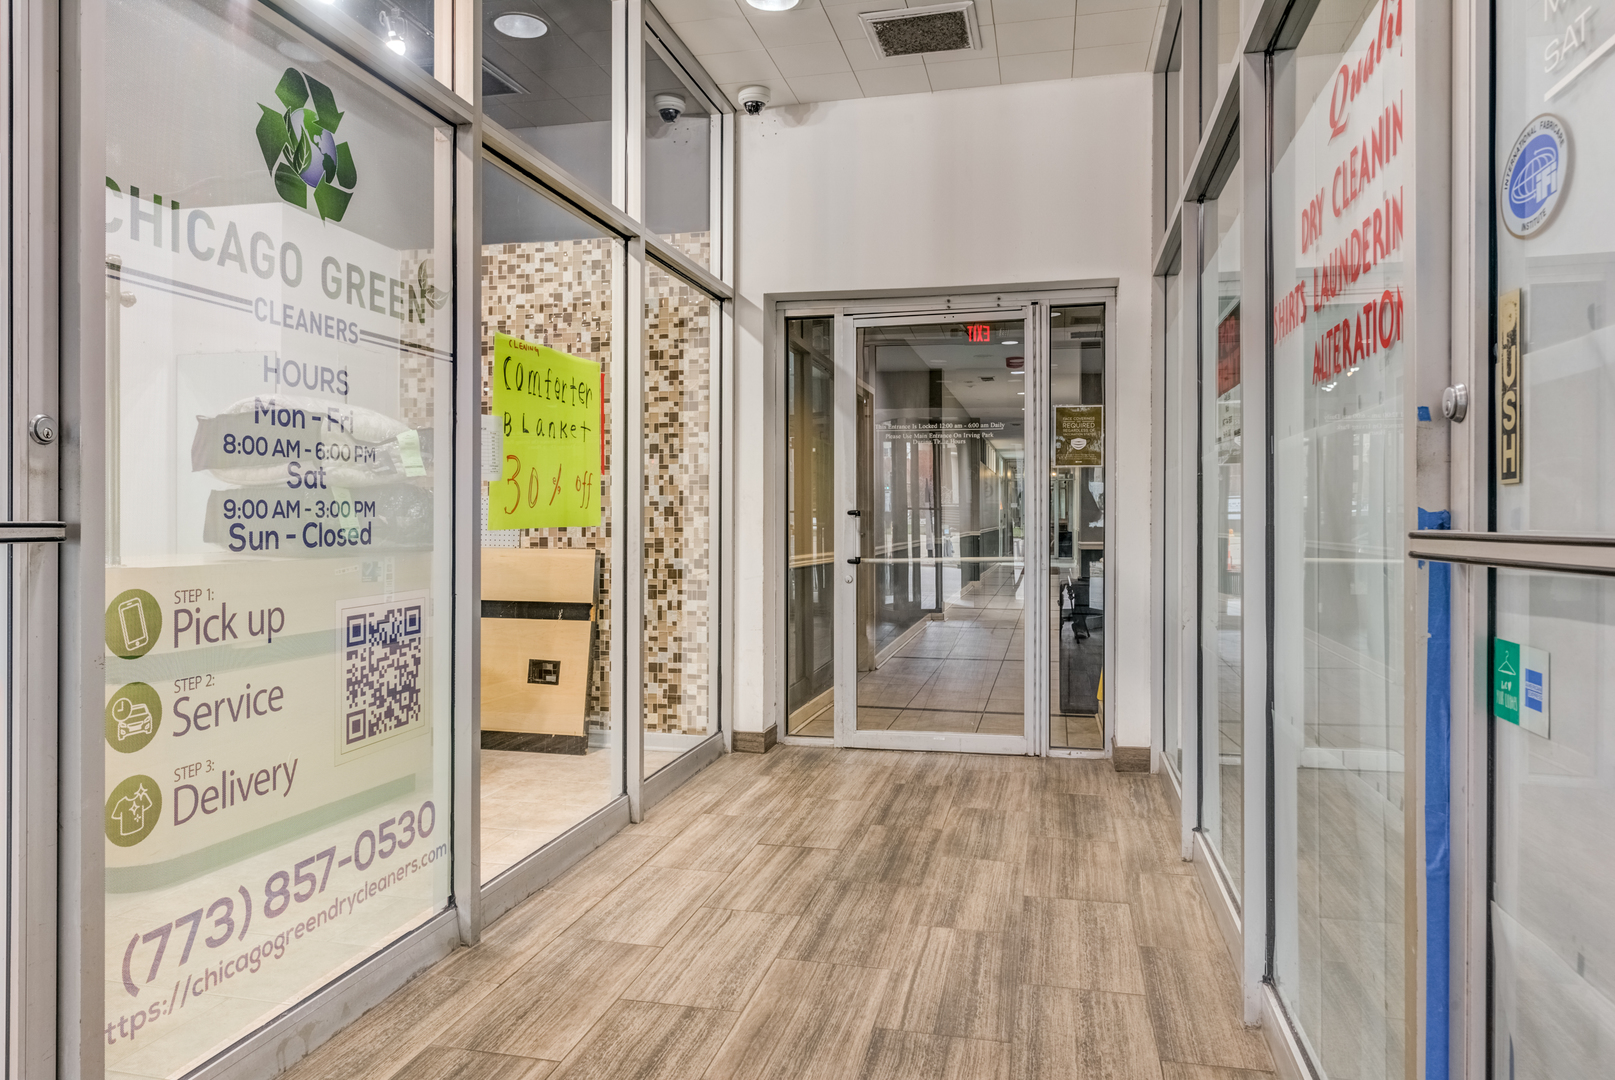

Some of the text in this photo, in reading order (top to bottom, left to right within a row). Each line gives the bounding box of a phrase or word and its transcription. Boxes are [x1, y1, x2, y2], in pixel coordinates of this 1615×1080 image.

[1544, 6, 1592, 73] SAT
[1301, 90, 1403, 254] DRY CLEANIN
[1504, 125, 1537, 190] INTERNATIONAL
[1521, 207, 1547, 232] INSTITUTE
[105, 176, 426, 326] CHICAGO GREEN
[1274, 185, 1403, 344] SHIRTS LAUNDERIN
[254, 297, 360, 344] CLEANERS
[263, 355, 350, 396] HOURS
[254, 397, 306, 430] Mon
[327, 407, 354, 435] Fri
[990, 422, 1006, 430] Daily
[223, 434, 269, 457] 8:00
[272, 438, 301, 458] AM
[315, 442, 351, 462] 6:00
[354, 445, 376, 463] PM
[286, 462, 327, 490] Sat
[223, 499, 268, 519] 9:00
[272, 500, 301, 519] AM
[315, 500, 351, 518] 3:00
[354, 500, 376, 518] PM
[228, 523, 279, 552] Sun
[302, 521, 372, 548] Closed
[174, 588, 215, 605] STEP 1:
[173, 602, 285, 649] Pick up
[174, 674, 215, 693] STEP 2:
[172, 683, 284, 737] Service
[173, 758, 299, 826] Delivery
[174, 760, 215, 782] STEP 3:
[121, 800, 436, 998] (773) 857-0530
[104, 841, 447, 1045] ttps://chicagogreendrycleaners.com
